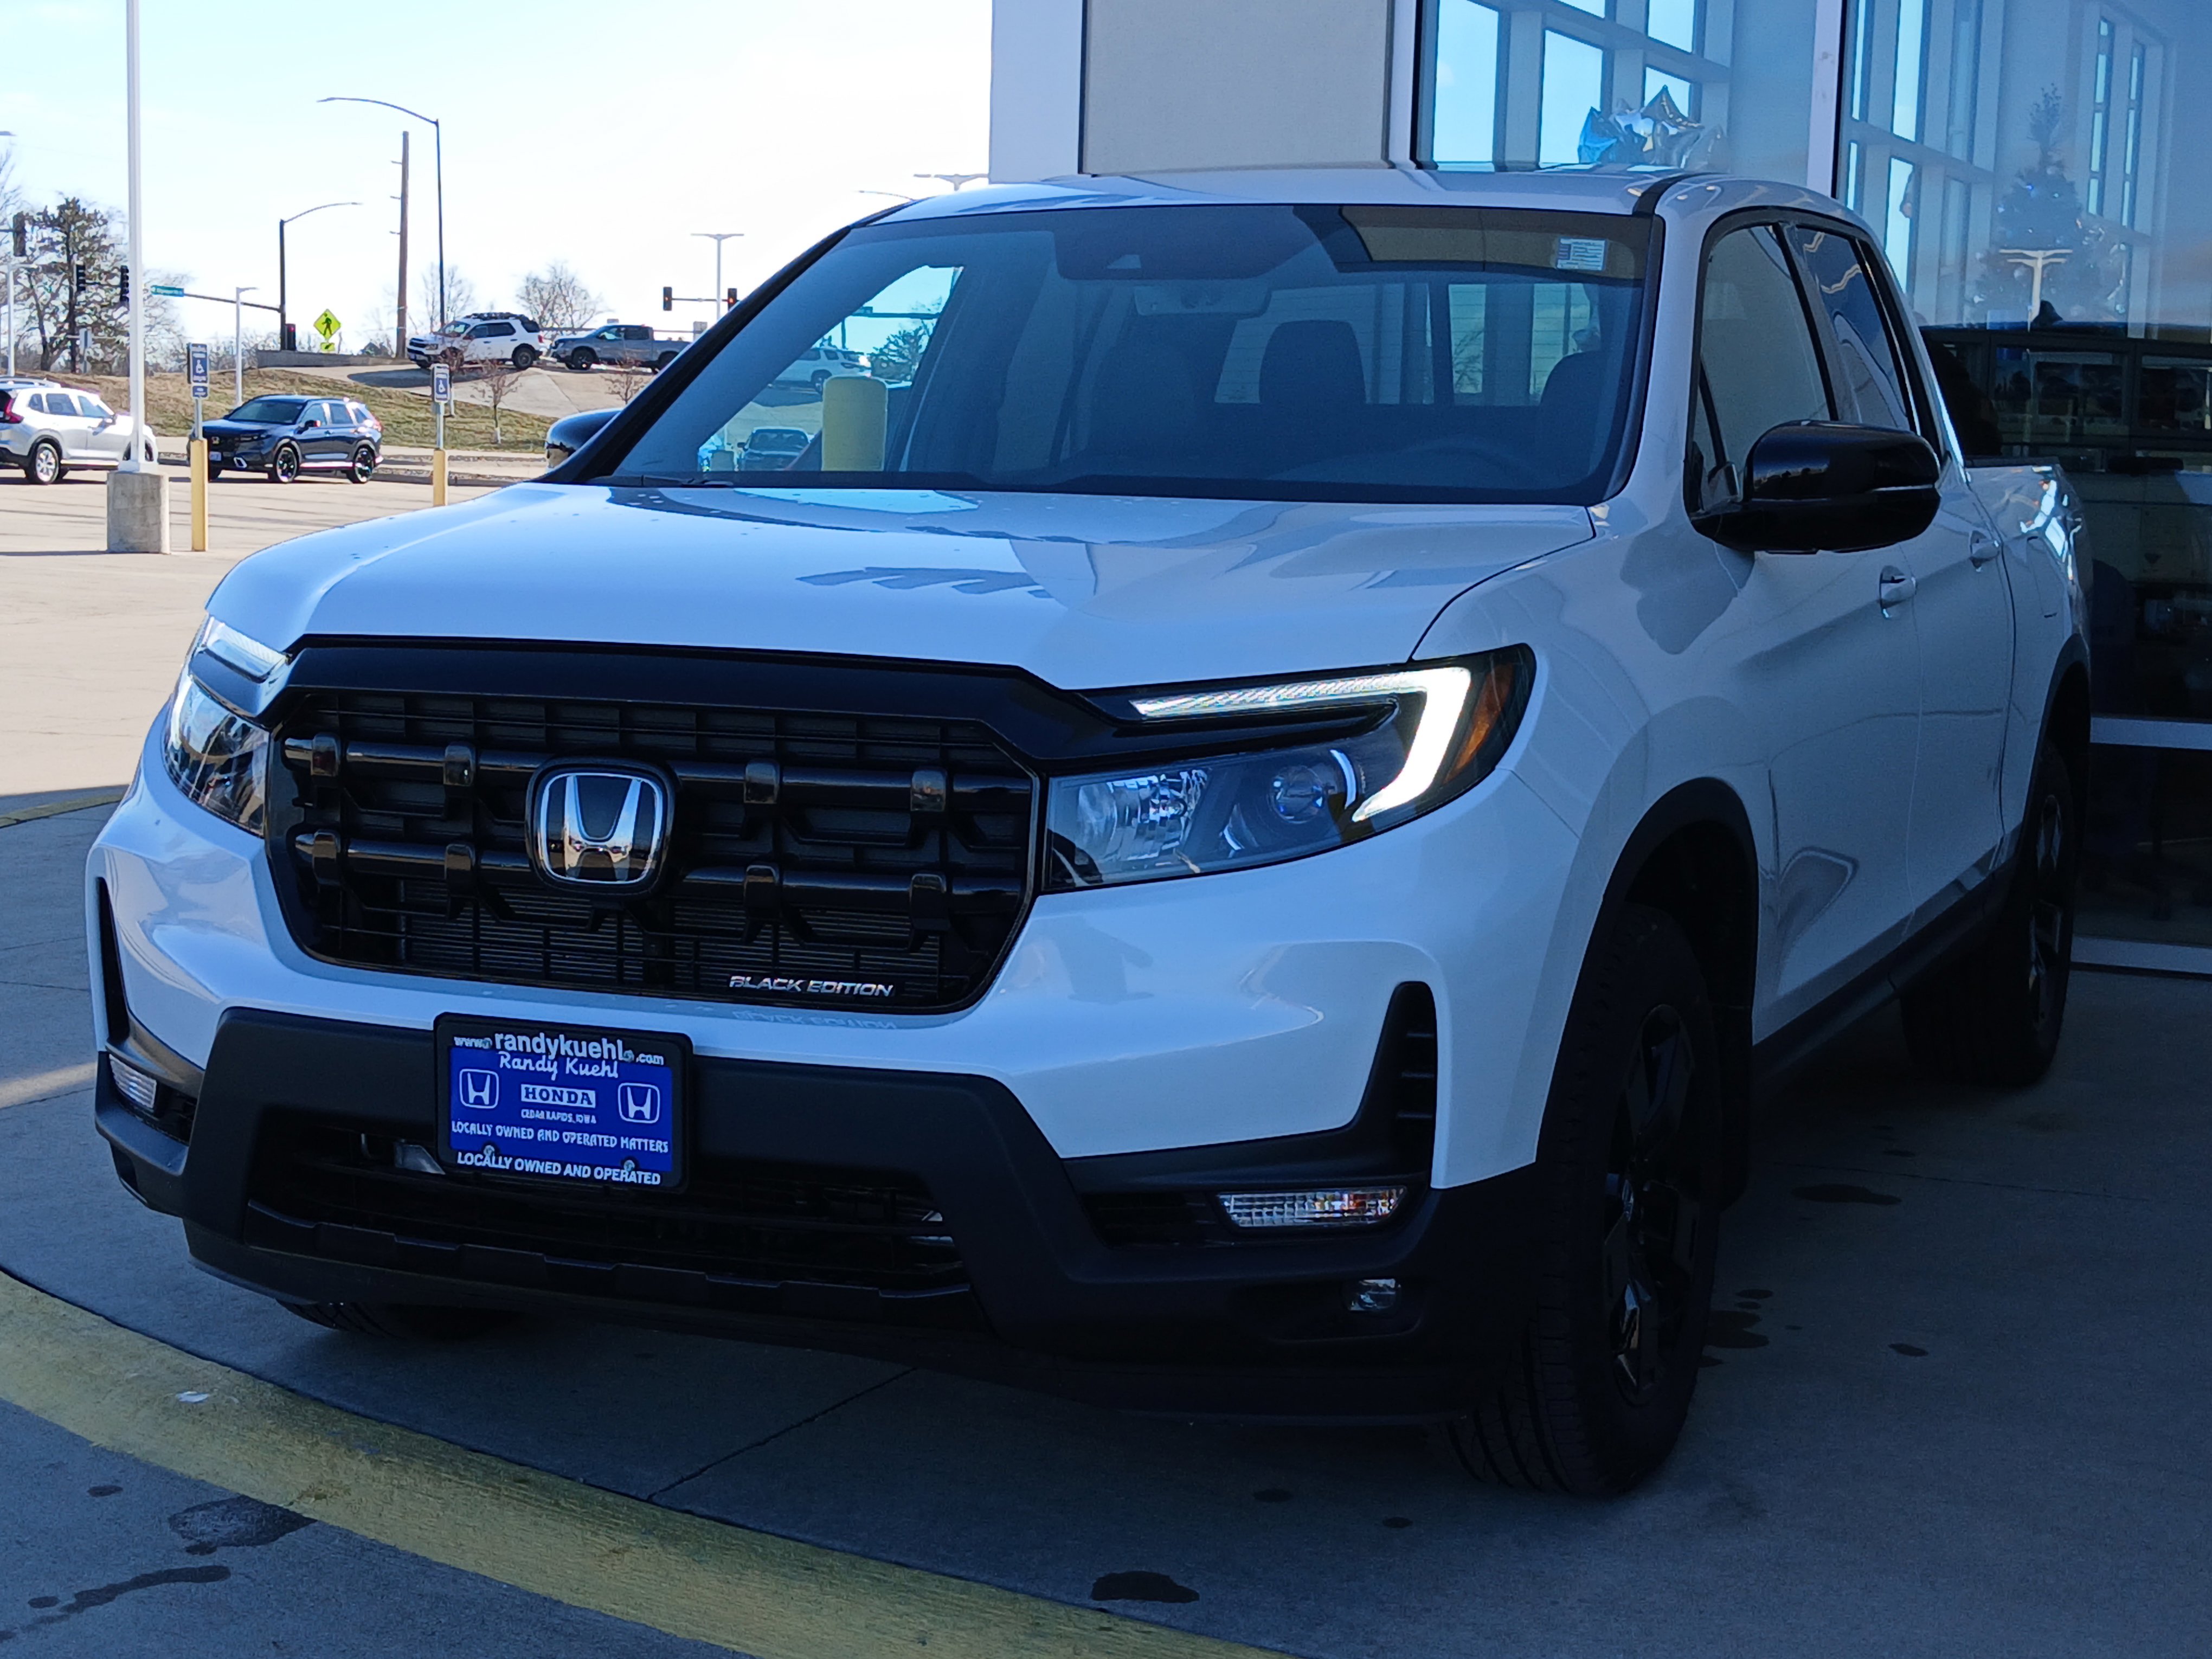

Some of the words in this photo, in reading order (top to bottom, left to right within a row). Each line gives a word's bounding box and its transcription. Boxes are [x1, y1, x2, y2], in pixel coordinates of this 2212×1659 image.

[729, 975, 807, 992] BLACK
[806, 980, 893, 997] EDITION
[496, 1051, 558, 1081] Randy
[565, 1057, 619, 1078] Kuehl
[524, 1086, 593, 1105] HONDA
[451, 1120, 493, 1137] LOCALLY
[495, 1124, 534, 1140] OWNED
[537, 1129, 560, 1142] AND
[562, 1131, 618, 1148] OPERATED
[620, 1136, 668, 1153] MATTERS
[457, 1152, 513, 1169] LOCALLY
[515, 1158, 562, 1175] OWNED
[563, 1163, 591, 1178] AND
[594, 1167, 661, 1185] OPERATED
